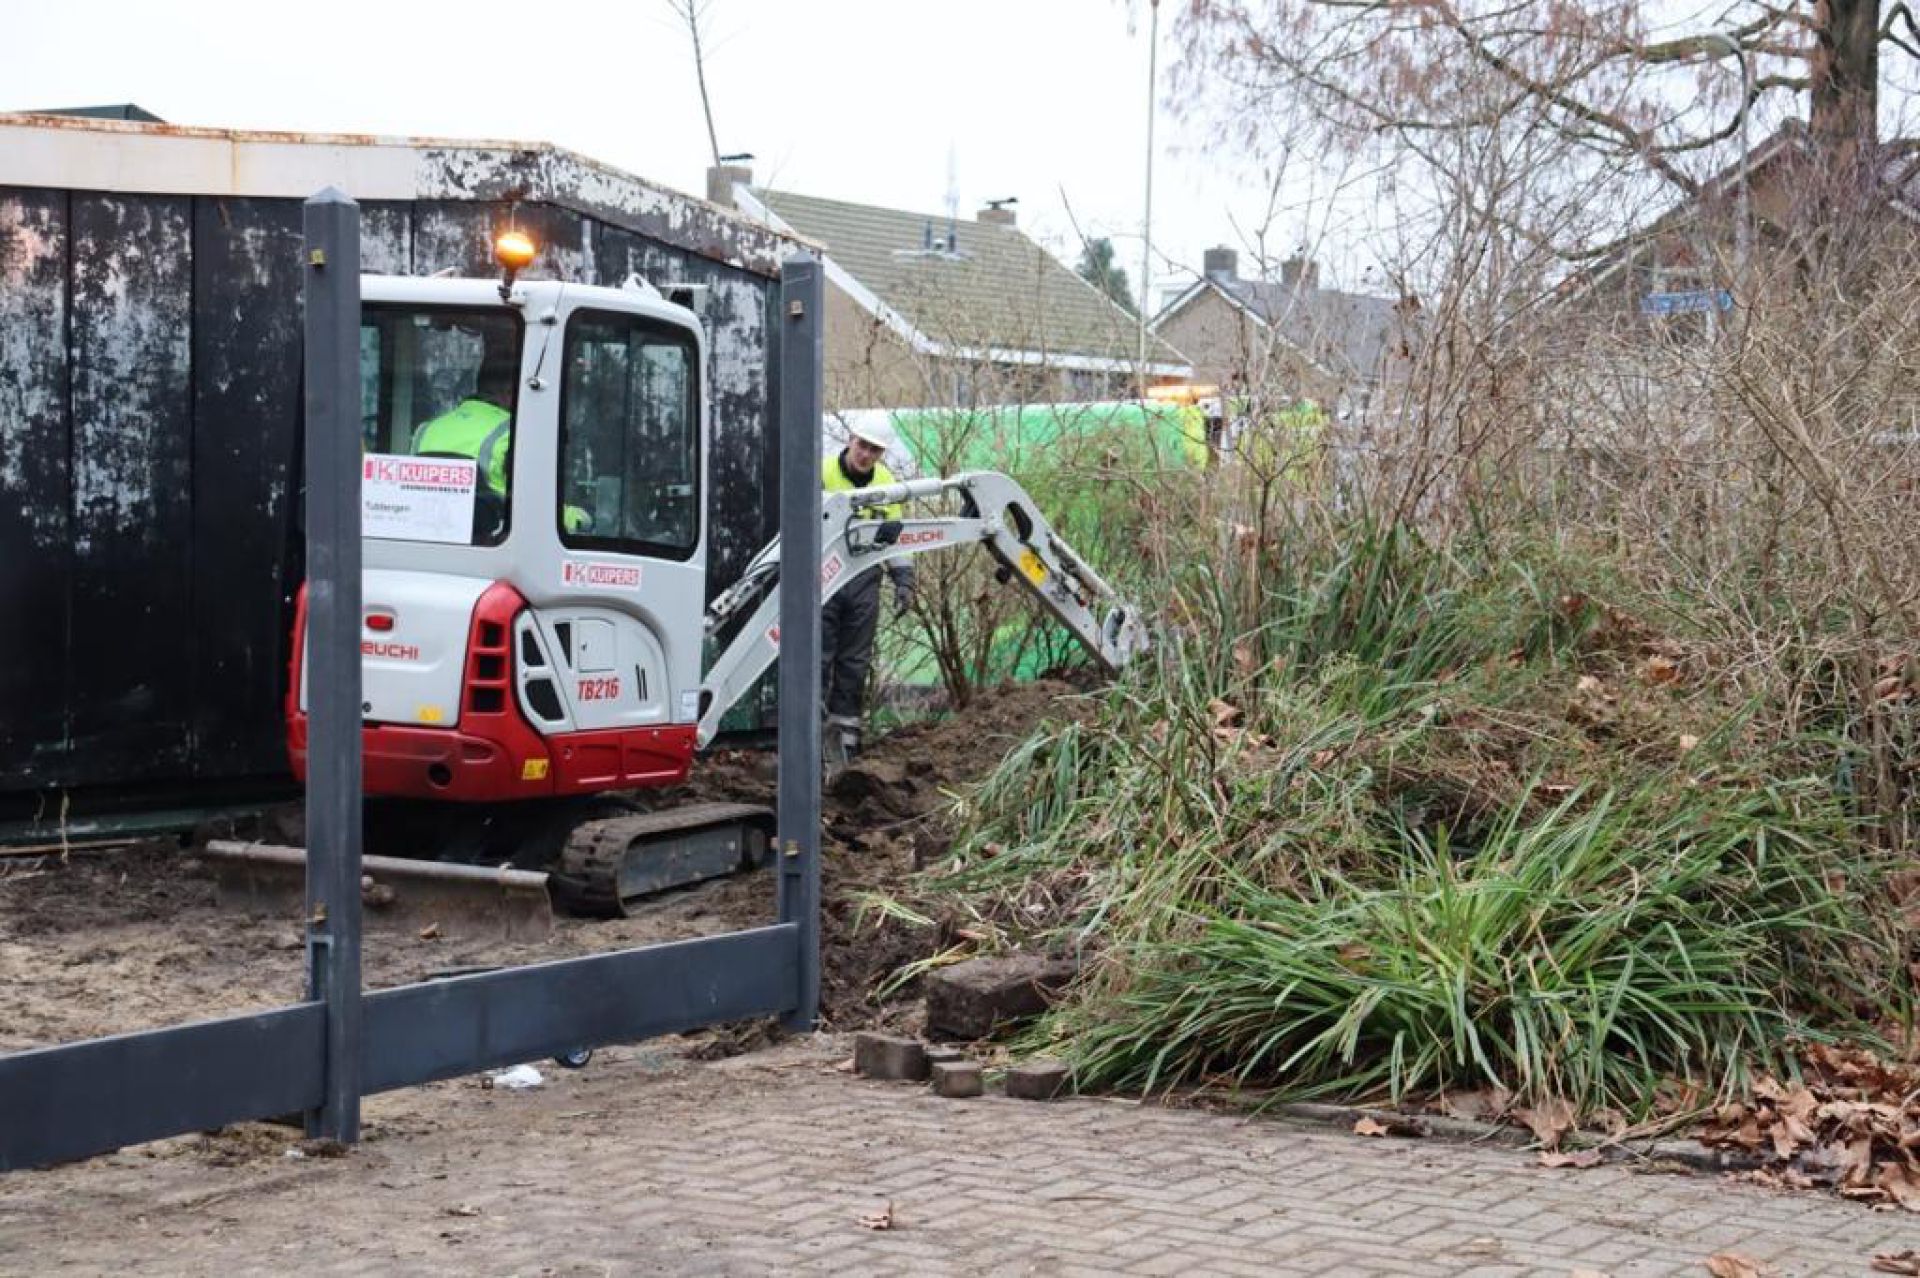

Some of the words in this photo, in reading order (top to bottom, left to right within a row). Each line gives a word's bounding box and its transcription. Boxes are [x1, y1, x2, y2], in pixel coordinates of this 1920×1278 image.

[401, 464, 473, 486] KUIPERS
[900, 529, 944, 545] EUCHI
[589, 566, 640, 587] KUIPERS
[361, 641, 419, 660] EUCHI
[578, 677, 620, 701] TB216
